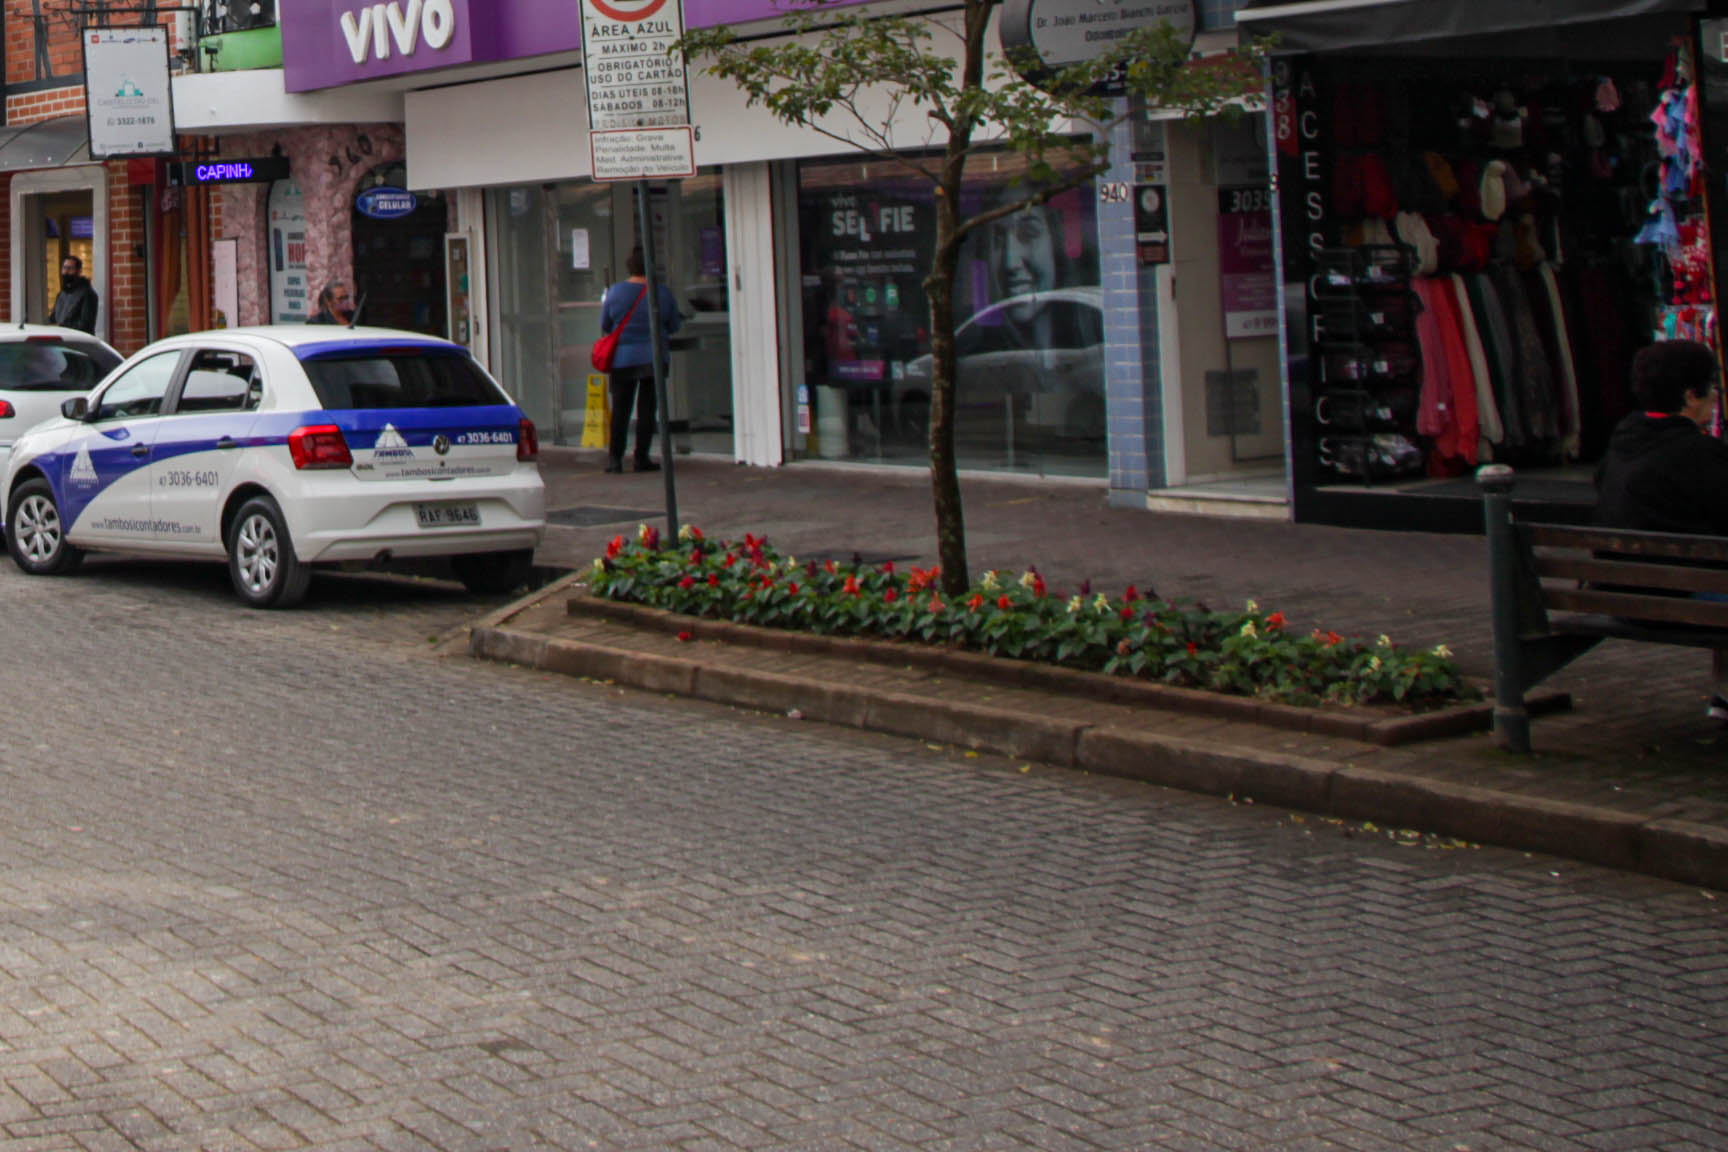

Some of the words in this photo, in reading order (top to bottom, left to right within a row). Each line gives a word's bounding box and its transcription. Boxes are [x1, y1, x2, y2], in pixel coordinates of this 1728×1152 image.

[592, 24, 630, 38] ÁREA
[636, 21, 674, 34] AZUL
[653, 41, 666, 51] 2h
[598, 57, 673, 73] OBRIGATÓRIO
[590, 74, 613, 84] USO
[617, 72, 633, 82] DO
[638, 68, 682, 80] CARTÃO
[592, 90, 616, 100] DIAS
[1100, 183, 1129, 202] 940
[466, 431, 513, 443] 3036-6401
[167, 471, 219, 487] 3036-6401
